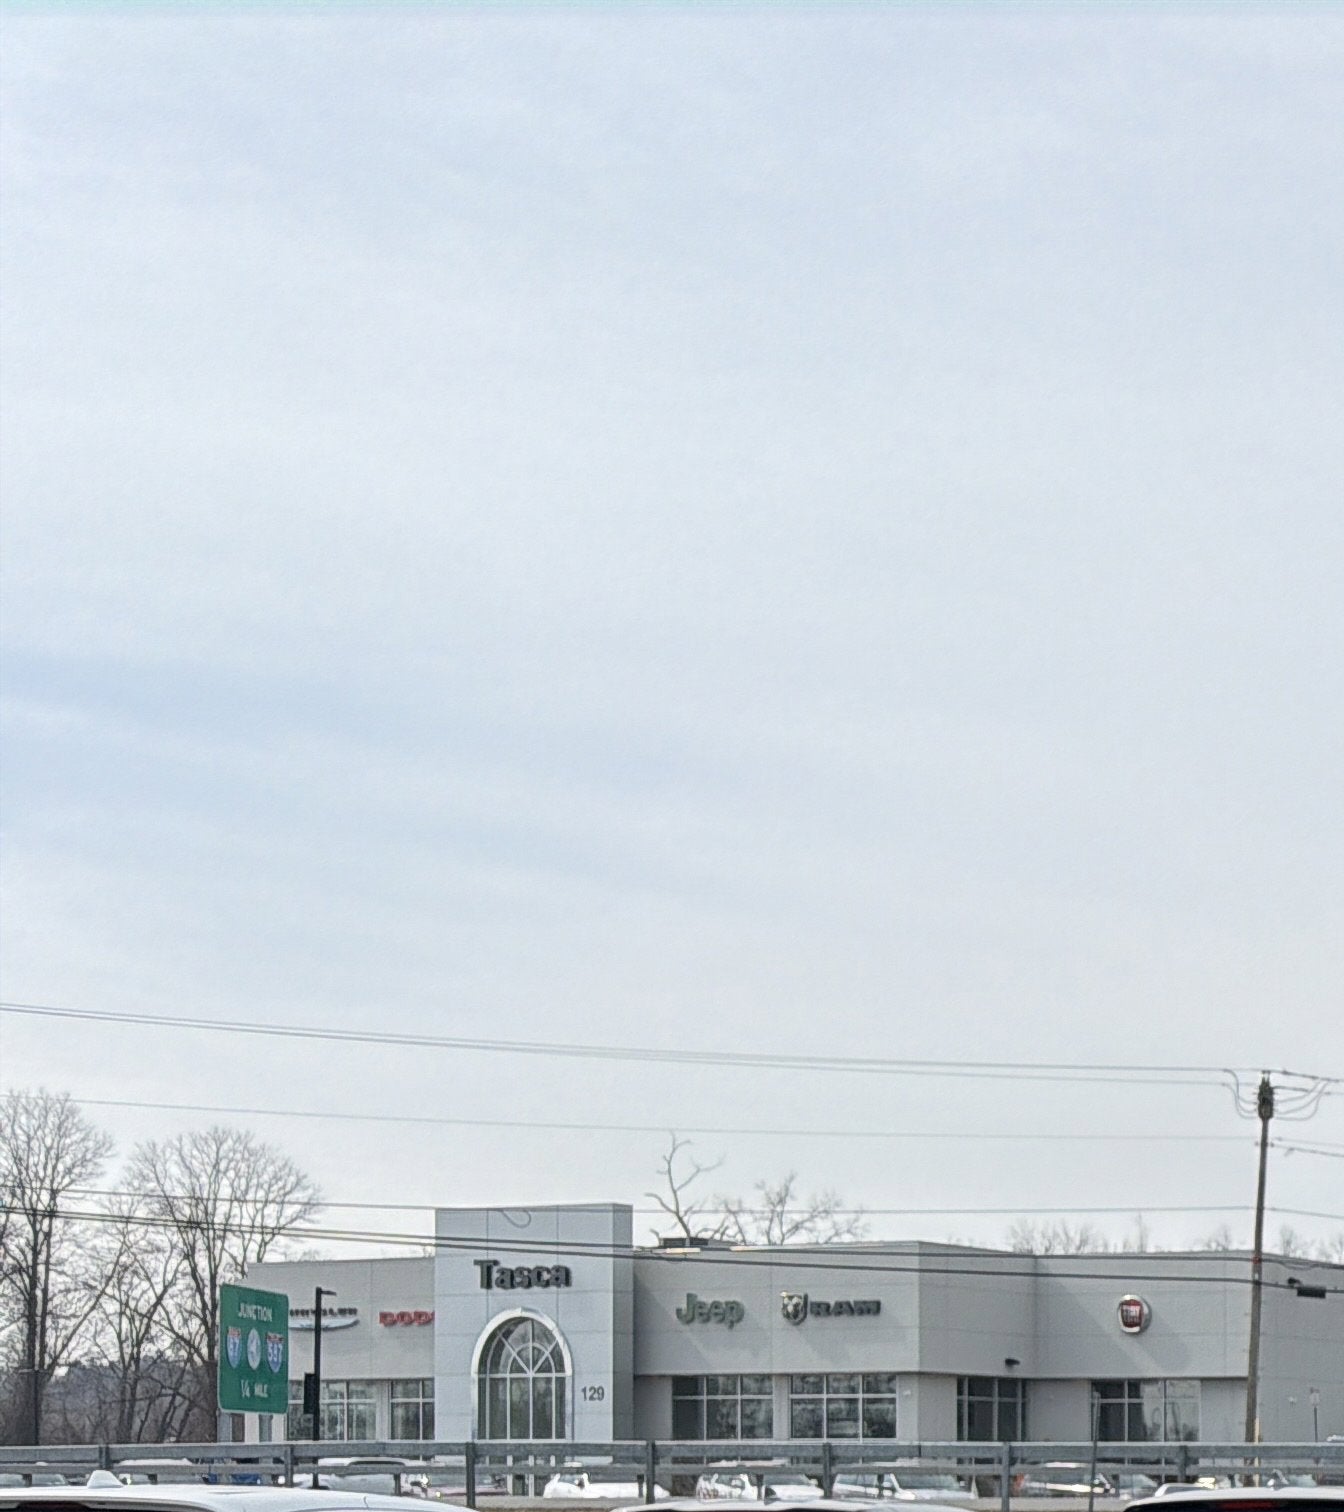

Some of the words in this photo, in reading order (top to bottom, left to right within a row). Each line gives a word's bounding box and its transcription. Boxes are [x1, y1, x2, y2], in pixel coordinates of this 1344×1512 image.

[473, 1259, 573, 1291] Tasca
[238, 1302, 273, 1322] JUNCTION
[676, 1293, 745, 1329] Jeep
[810, 1300, 881, 1316] RAM
[379, 1310, 435, 1327] DOD
[581, 1386, 606, 1402] 129
